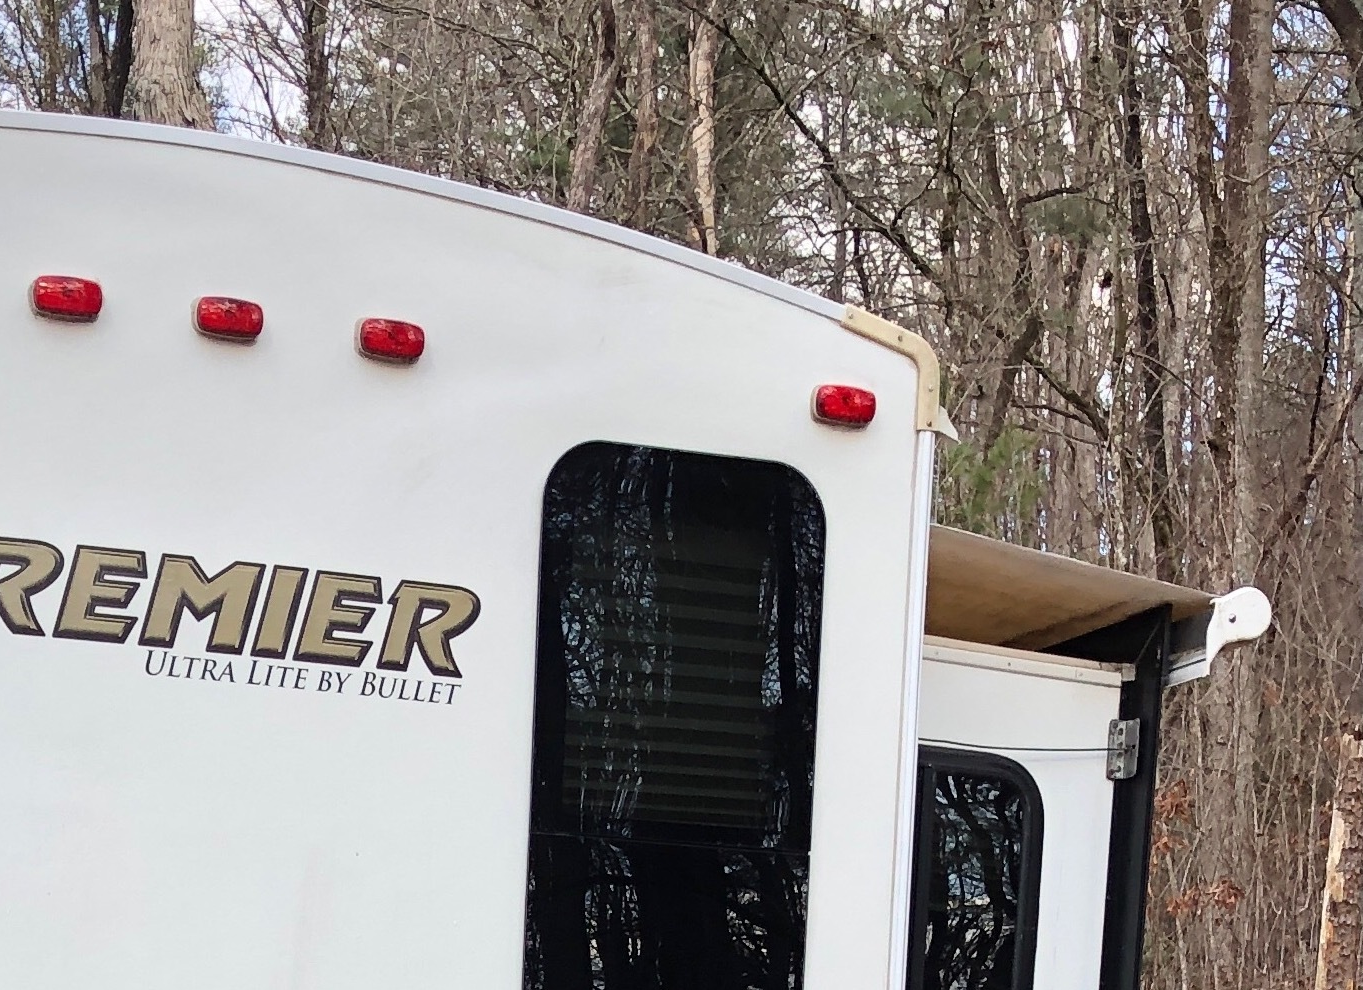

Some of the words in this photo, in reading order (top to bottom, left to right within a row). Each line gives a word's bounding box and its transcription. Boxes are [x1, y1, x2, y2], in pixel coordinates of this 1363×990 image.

[144, 650, 236, 683] ULTRA
[245, 660, 308, 690] LITE
[316, 671, 353, 694] BY
[360, 671, 463, 705] BULLET
